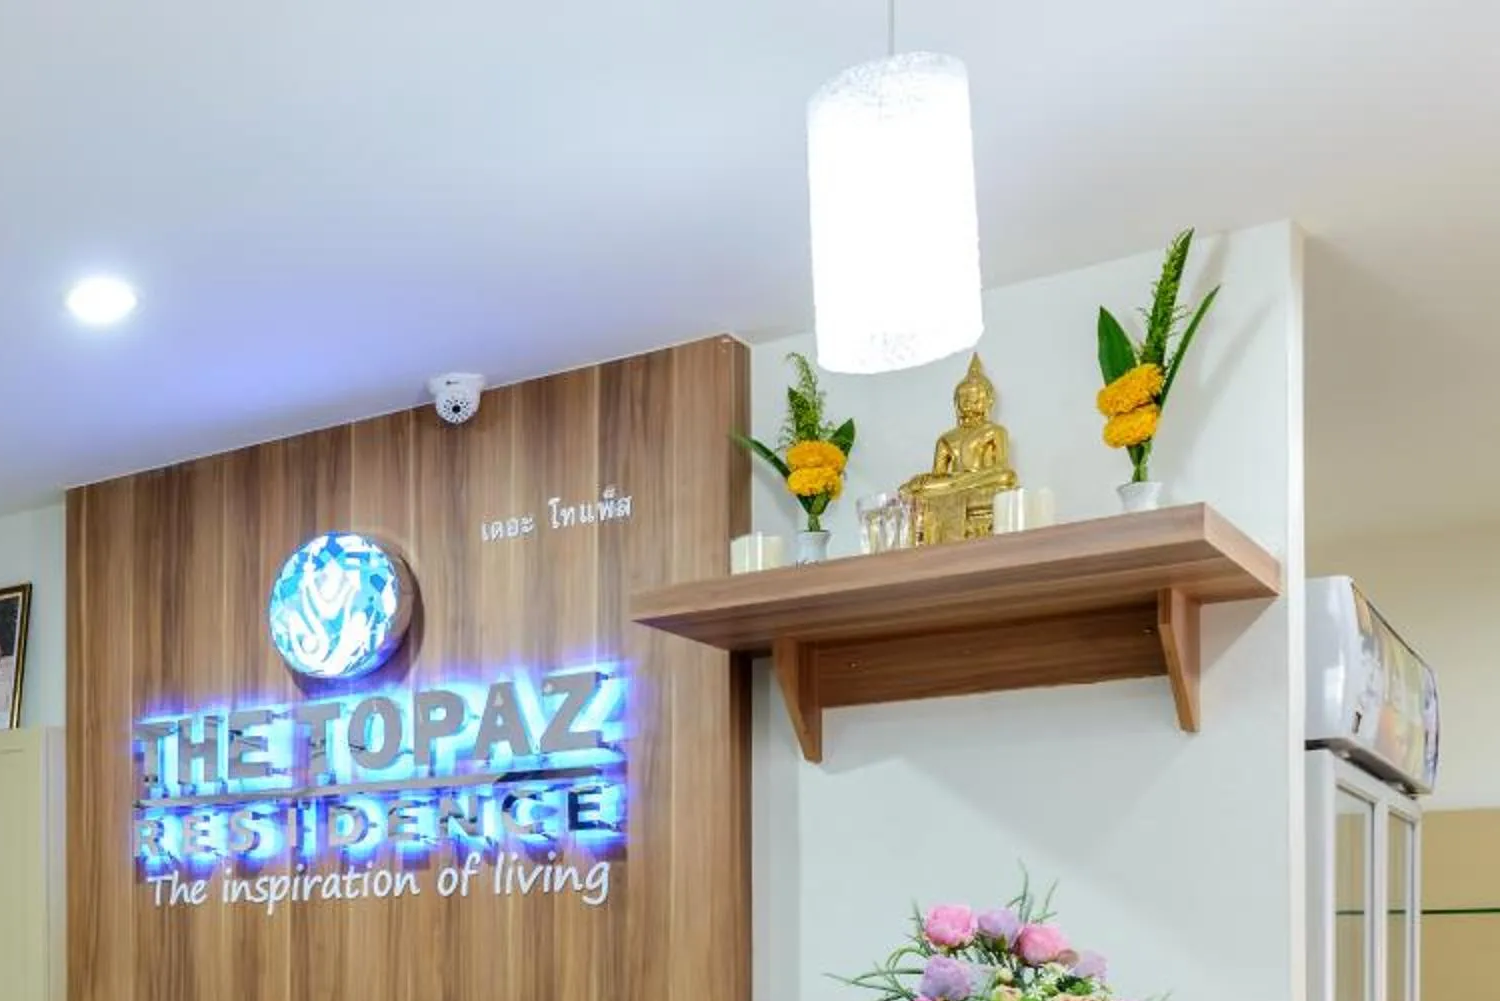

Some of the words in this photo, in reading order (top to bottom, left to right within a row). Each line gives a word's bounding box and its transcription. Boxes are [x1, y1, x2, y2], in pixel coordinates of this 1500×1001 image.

[136, 708, 282, 790] THE
[298, 670, 607, 782] TOPAZ
[134, 784, 609, 858] RESIDENCE
[146, 869, 210, 907] The
[222, 860, 421, 916] inspiration
[437, 851, 481, 898] of
[493, 851, 611, 906] living
